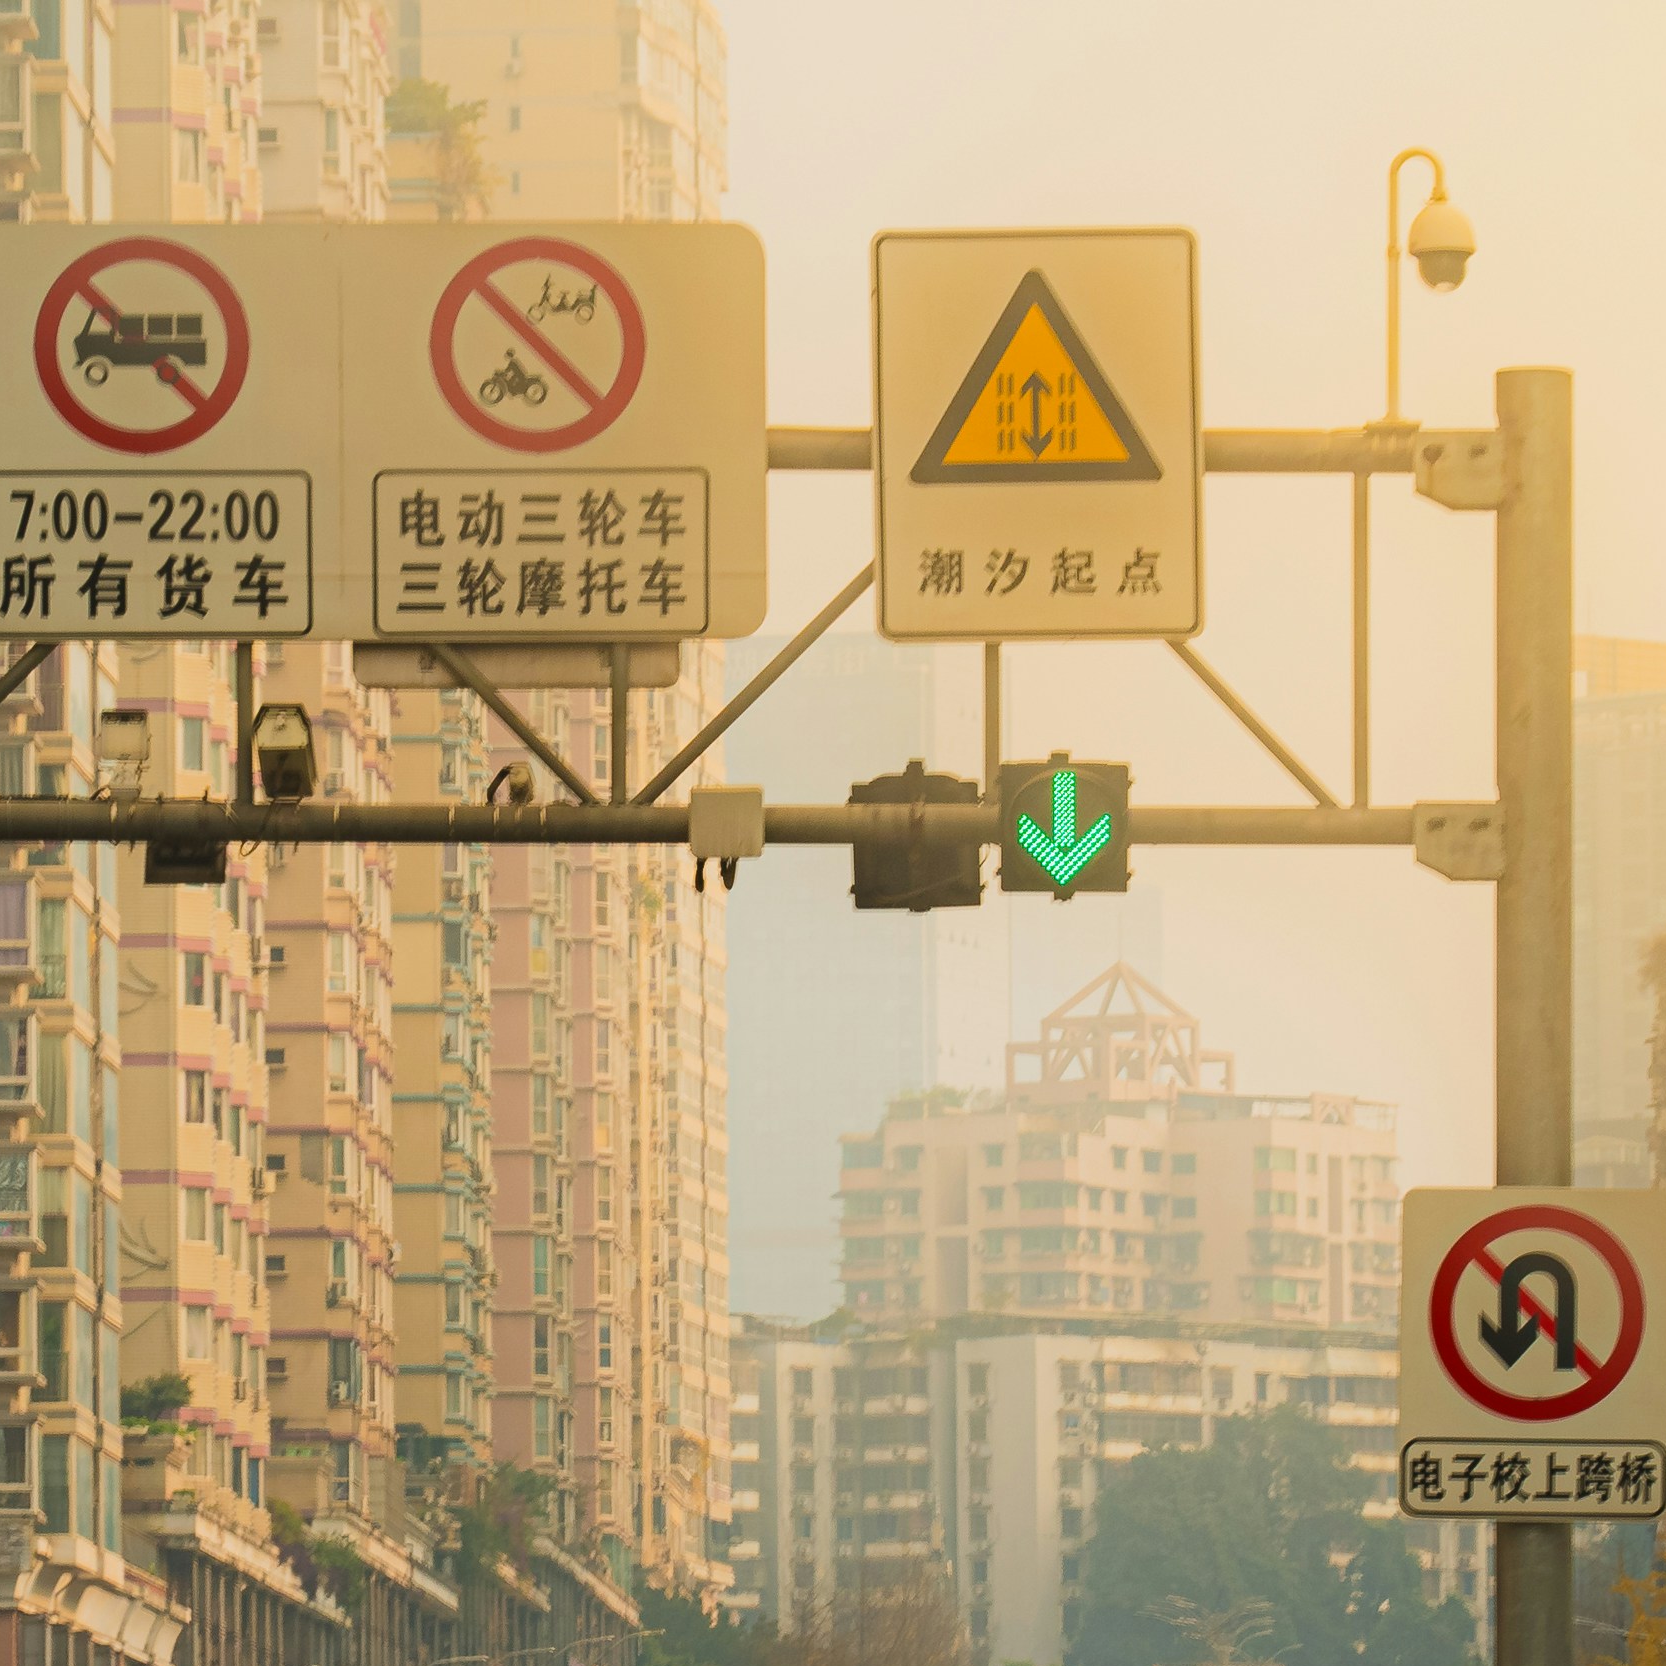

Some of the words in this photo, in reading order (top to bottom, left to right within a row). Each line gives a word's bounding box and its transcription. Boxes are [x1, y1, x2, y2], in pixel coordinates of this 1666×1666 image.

[8, 487, 280, 545] 7:00-22:00
[398, 486, 688, 550] 电动三轮车
[396, 556, 688, 617] 三轮摩托车
[917, 545, 1163, 597] 潮汐起点
[1409, 1450, 1659, 1504] 电子校上跨桥
